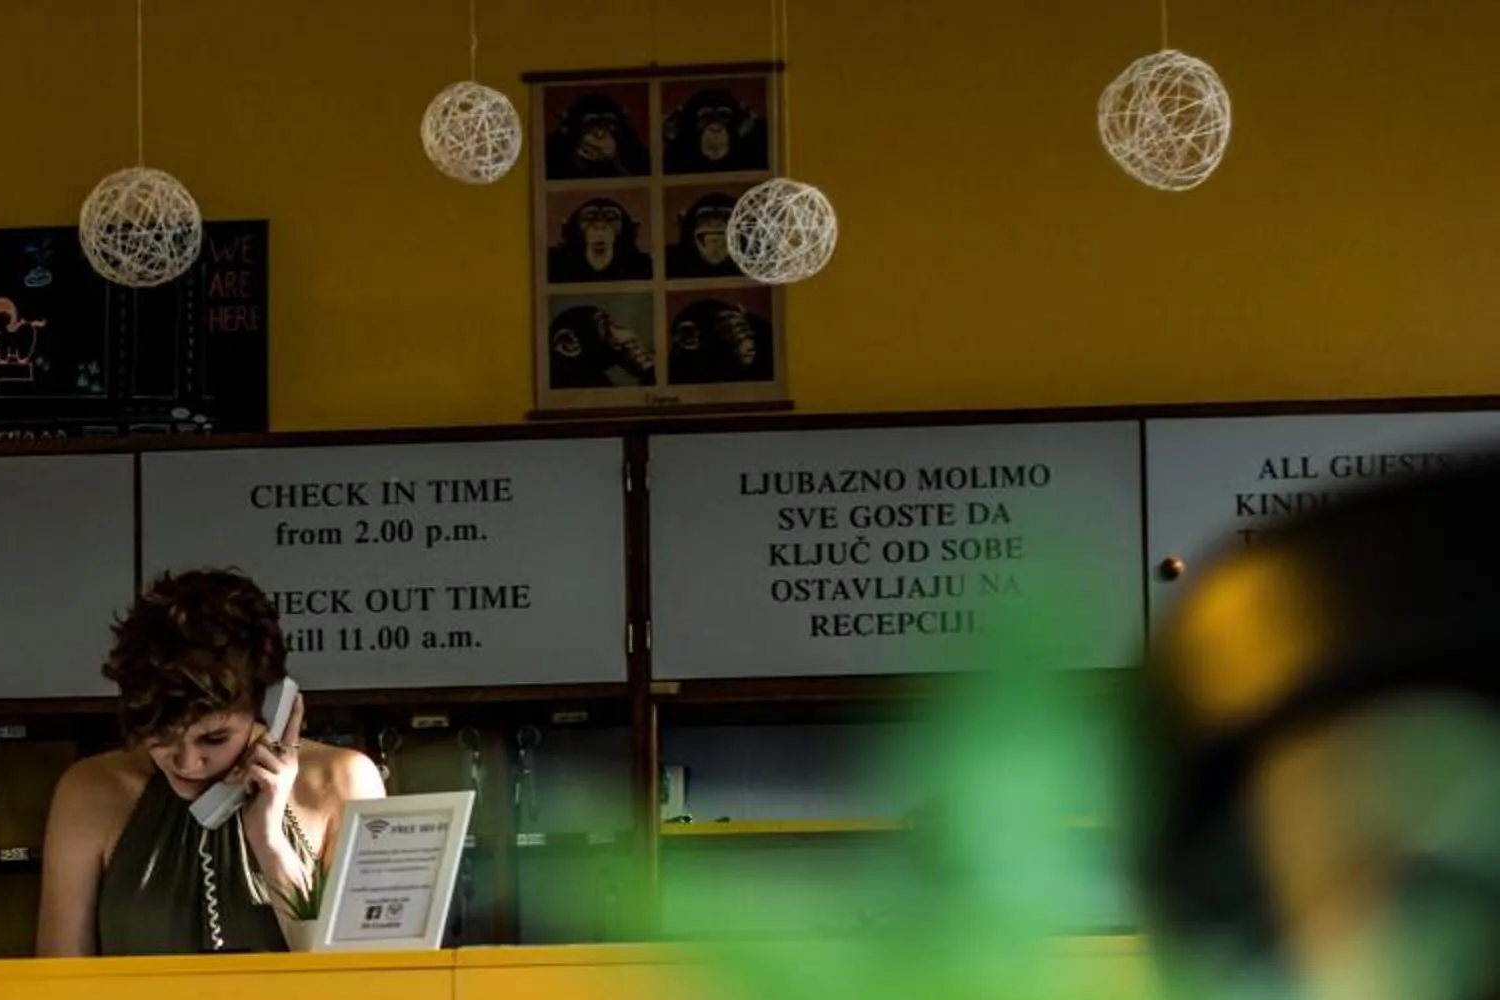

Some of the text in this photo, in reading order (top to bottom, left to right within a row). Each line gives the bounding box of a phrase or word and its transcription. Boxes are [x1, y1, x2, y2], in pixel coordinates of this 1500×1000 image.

[209, 235, 259, 264] WE
[208, 271, 255, 299] ARE
[208, 304, 260, 334] HERE
[739, 463, 1051, 495] LJUBAZNO MOLIMO
[1258, 456, 1318, 480] ALL
[250, 478, 513, 509] CHECK IN TIME
[777, 501, 1012, 531] SVE GOSTE DA
[275, 519, 488, 548] from 2.00 p.m.
[768, 535, 1024, 567] KLJUČ OD SOBE
[269, 585, 531, 615] HECK OUT TIME
[770, 575, 964, 602] OSTAVLJAJU
[285, 626, 482, 652] till 11.00 a.m.
